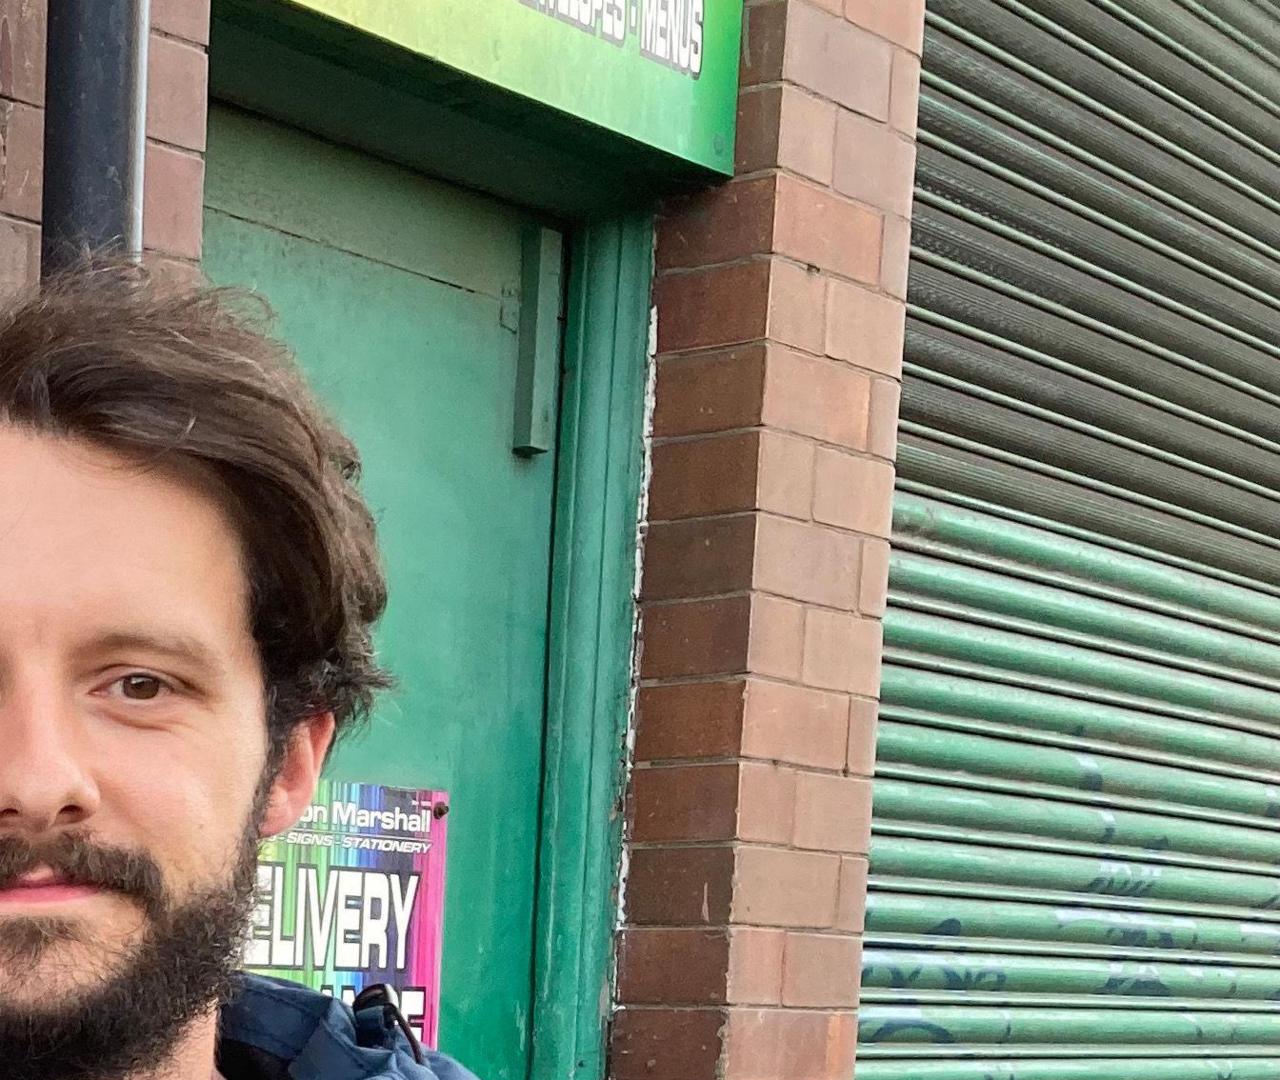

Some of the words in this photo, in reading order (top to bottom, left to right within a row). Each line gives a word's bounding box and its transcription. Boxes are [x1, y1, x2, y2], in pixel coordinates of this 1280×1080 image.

[641, 0, 703, 78] MENUS
[286, 832, 333, 848] SIGNS
[342, 838, 432, 854] STATIONERY
[332, 801, 431, 833] Marshall
[243, 862, 419, 969] ELIVERY
